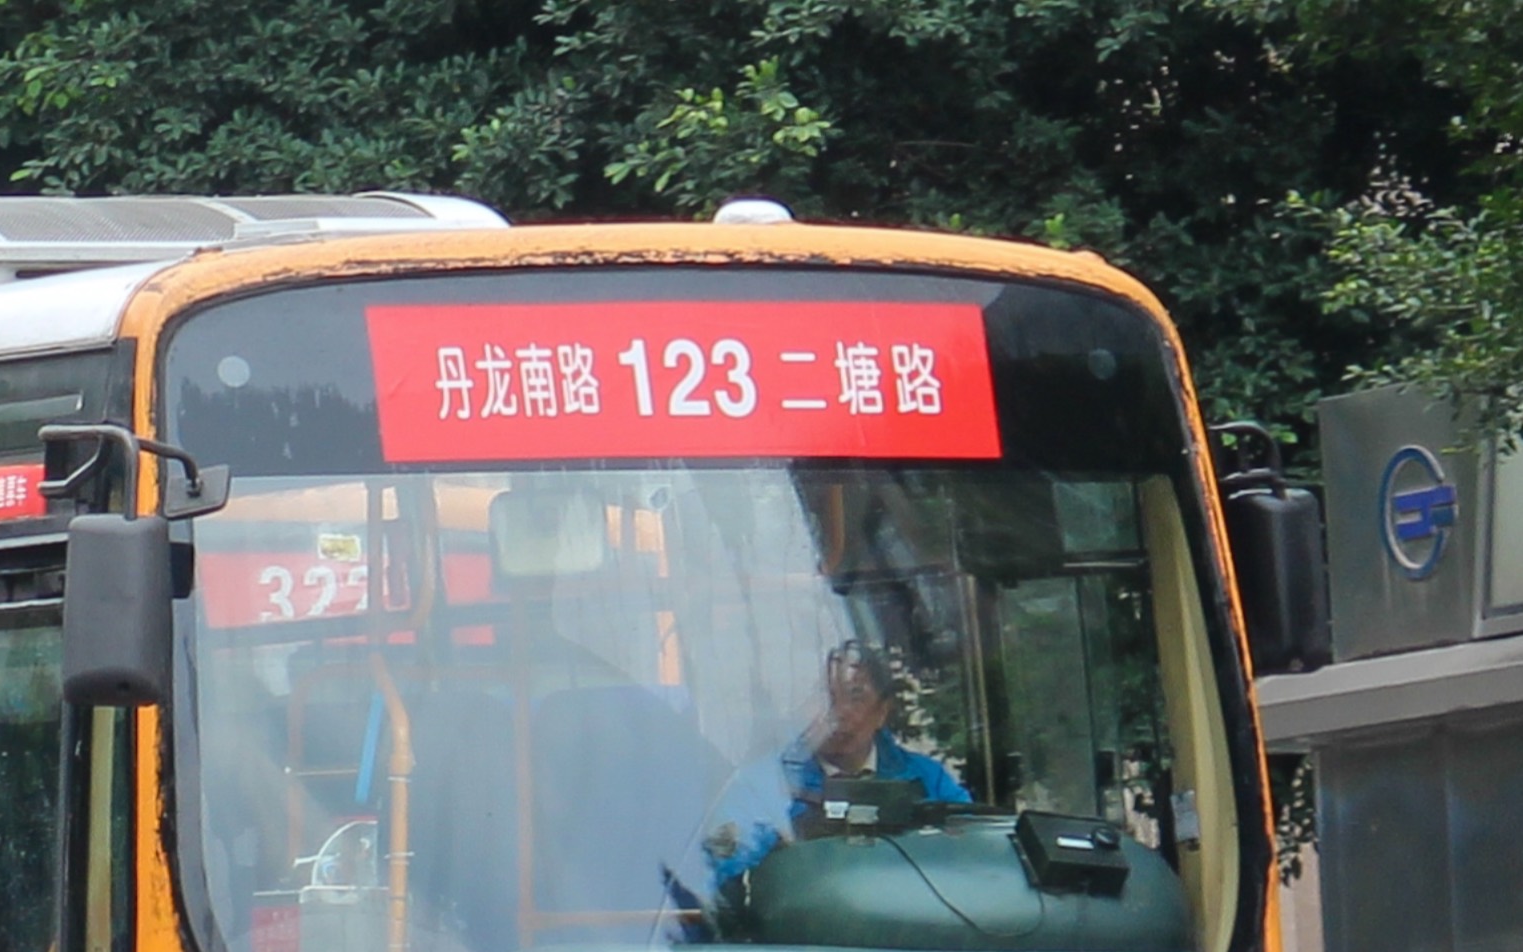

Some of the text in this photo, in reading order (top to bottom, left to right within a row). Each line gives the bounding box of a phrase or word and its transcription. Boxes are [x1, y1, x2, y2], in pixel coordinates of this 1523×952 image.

[435, 338, 942, 421] 丹龙南路 123 二塘路
